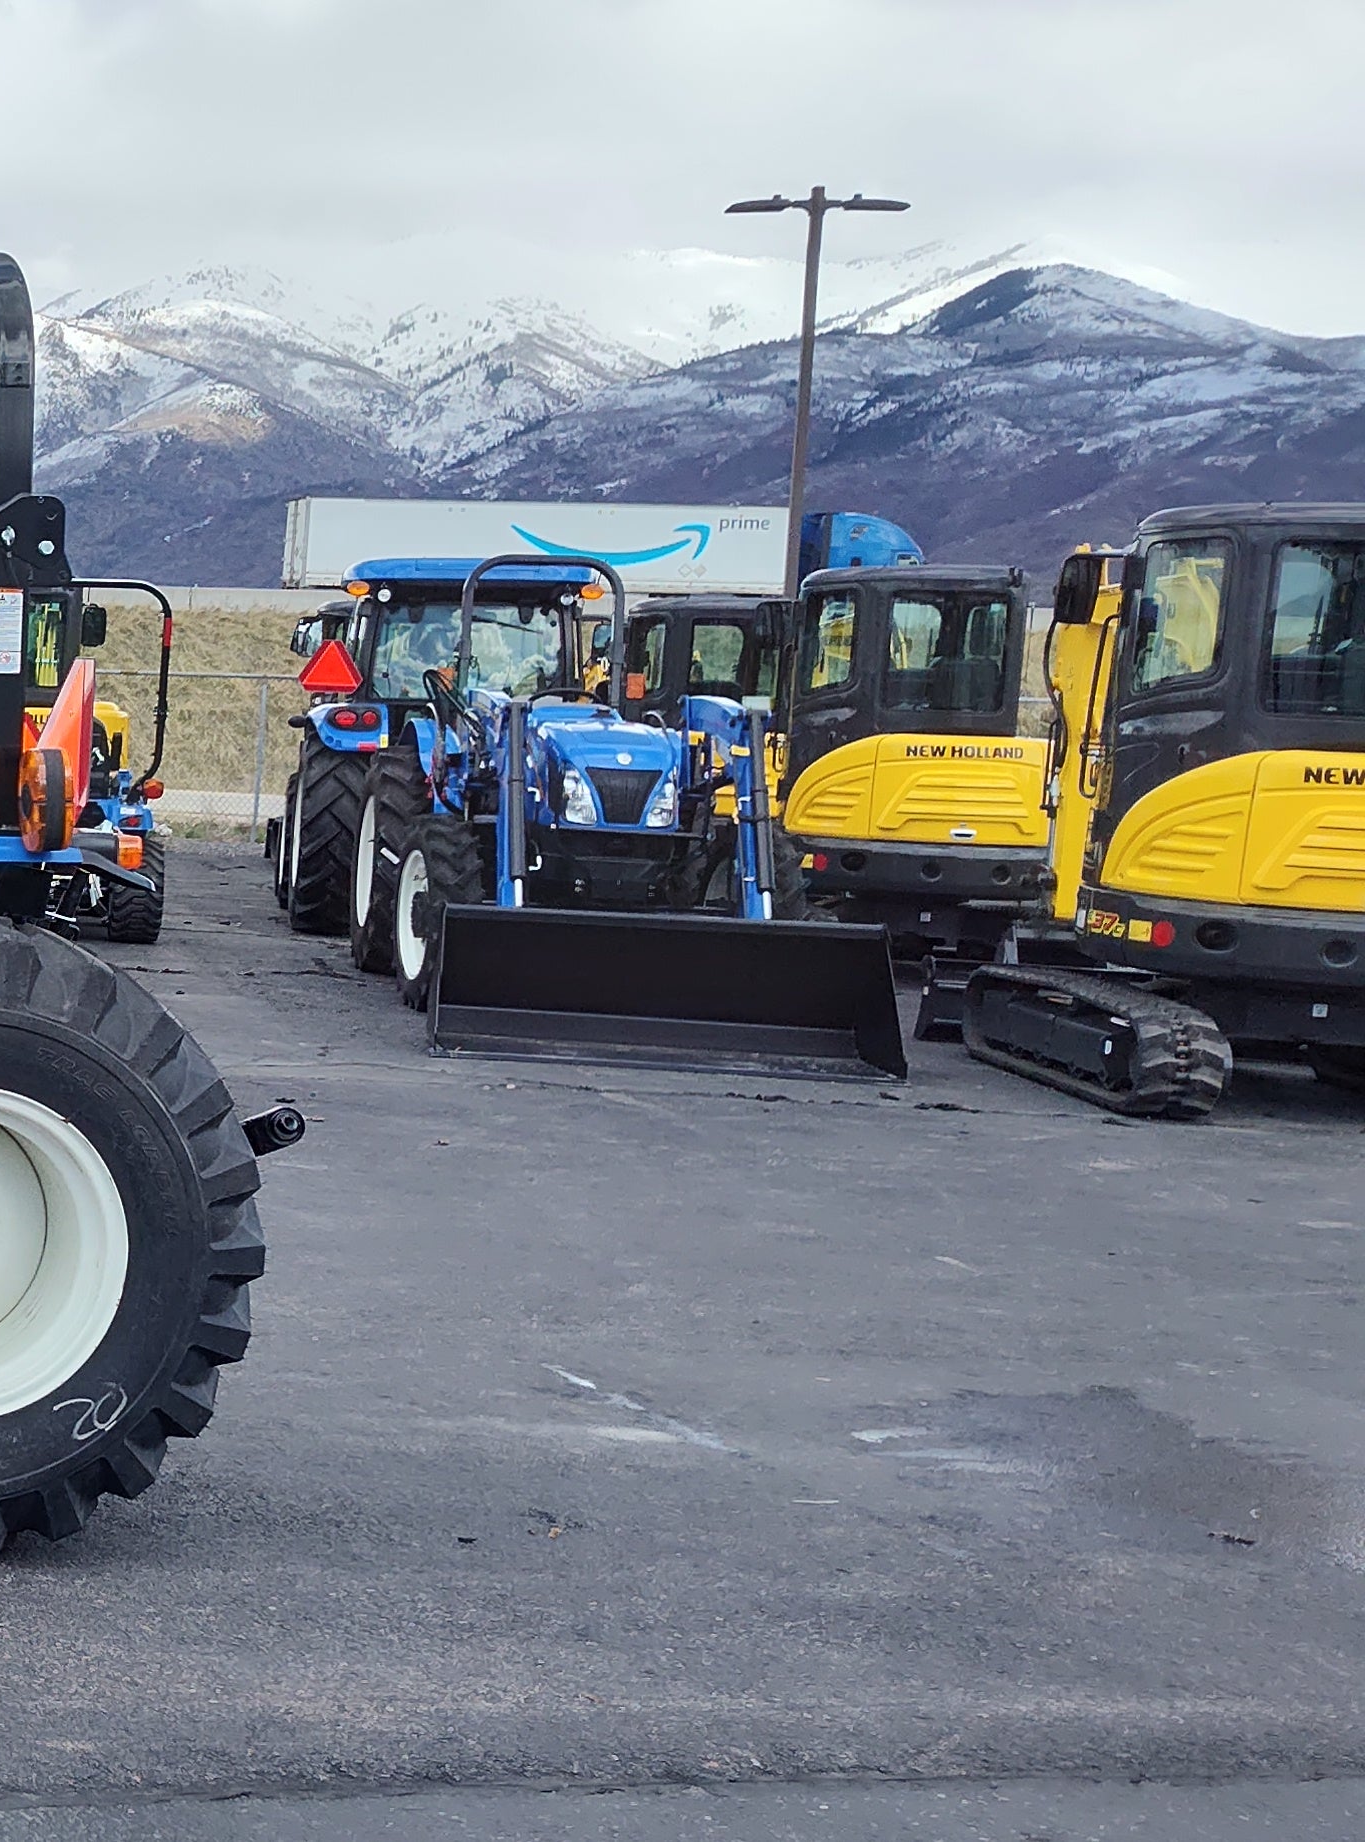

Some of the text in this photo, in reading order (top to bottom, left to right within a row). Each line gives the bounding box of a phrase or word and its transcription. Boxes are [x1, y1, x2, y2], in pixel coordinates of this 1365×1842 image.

[719, 514, 771, 532] prime
[906, 745, 1024, 759] NEW HOLLAND
[1304, 766, 1365, 785] NEW
